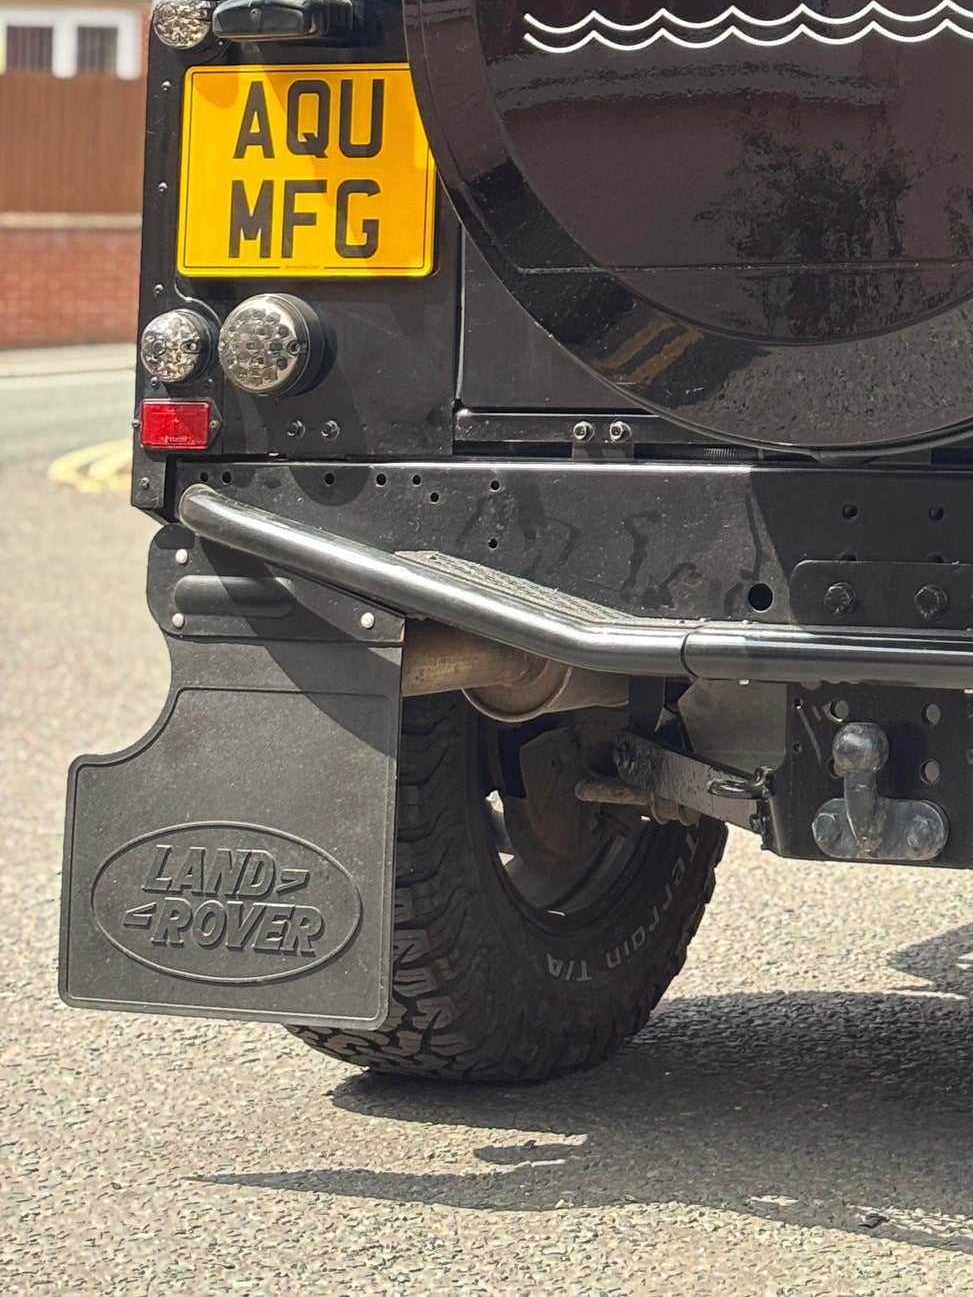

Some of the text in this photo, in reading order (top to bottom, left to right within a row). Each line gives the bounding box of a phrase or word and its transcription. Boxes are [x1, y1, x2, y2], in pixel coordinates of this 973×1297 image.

[233, 78, 385, 159] AQU
[228, 179, 382, 259] MFG
[142, 844, 276, 899] LAND
[150, 897, 325, 956] ROVER
